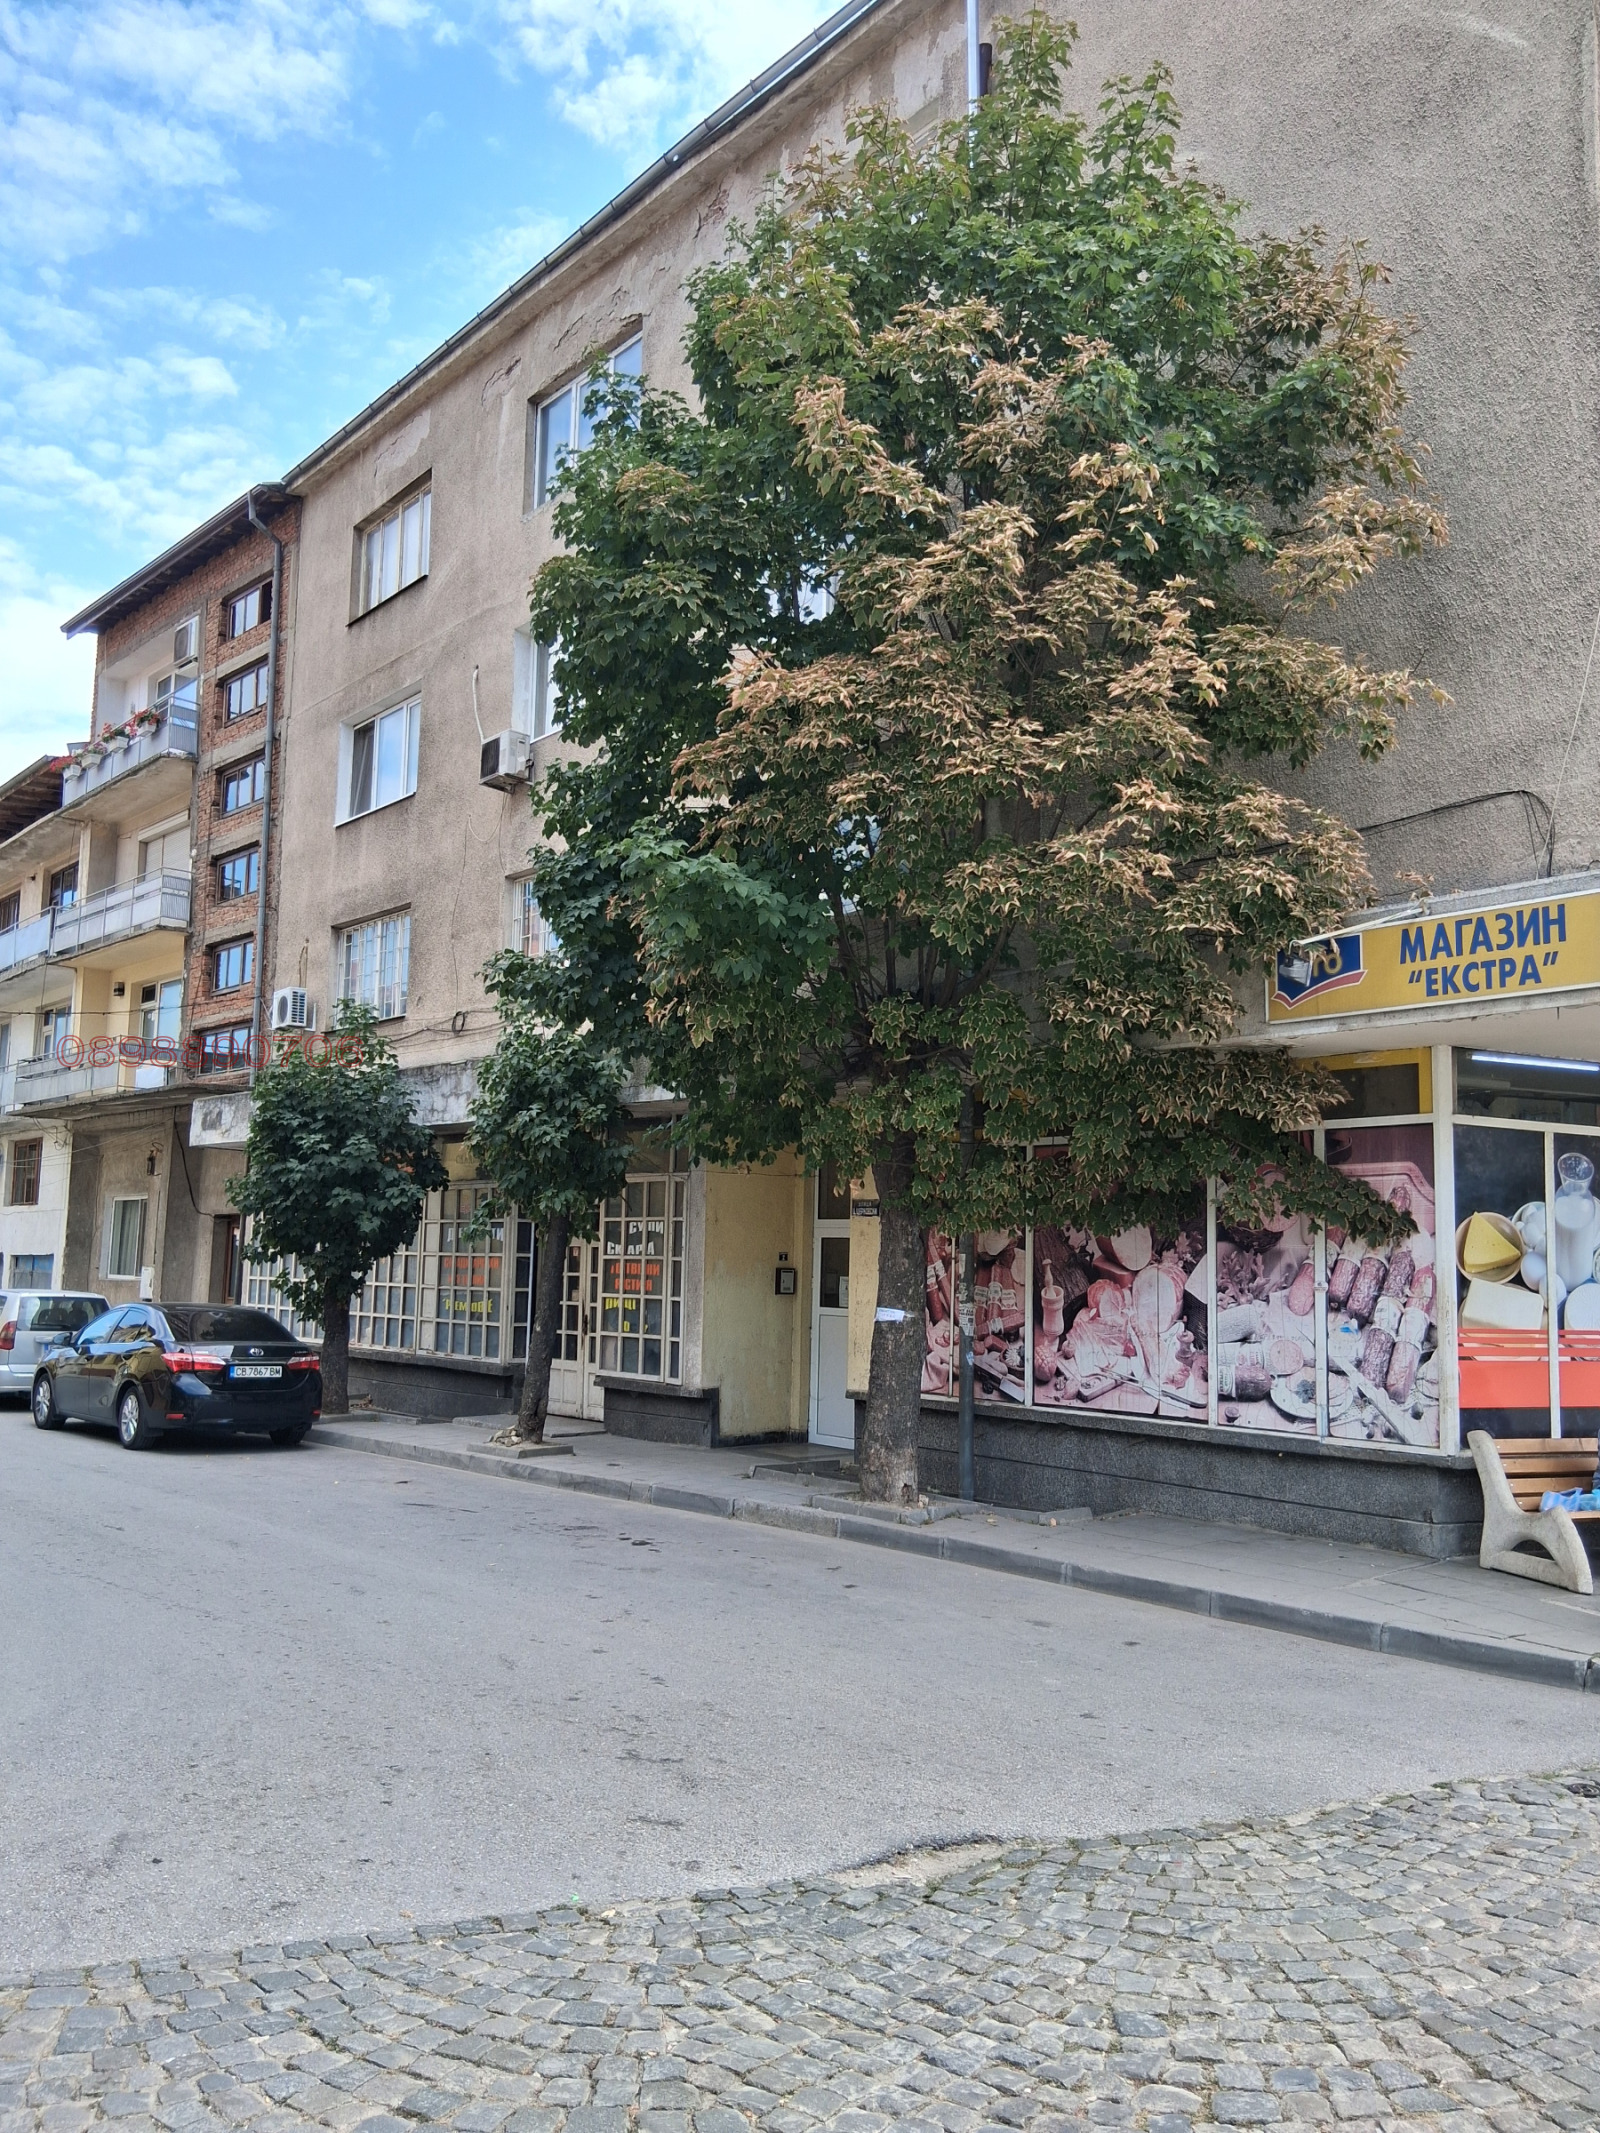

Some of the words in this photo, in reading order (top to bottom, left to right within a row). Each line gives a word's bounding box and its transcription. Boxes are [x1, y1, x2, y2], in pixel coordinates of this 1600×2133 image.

[1399, 903, 1567, 965] МАГАЗИН
[1408, 950, 1559, 997] "ЕКСТРА"
[629, 1221, 664, 1234] СУПИ
[606, 1241, 655, 1255] СКАРА
